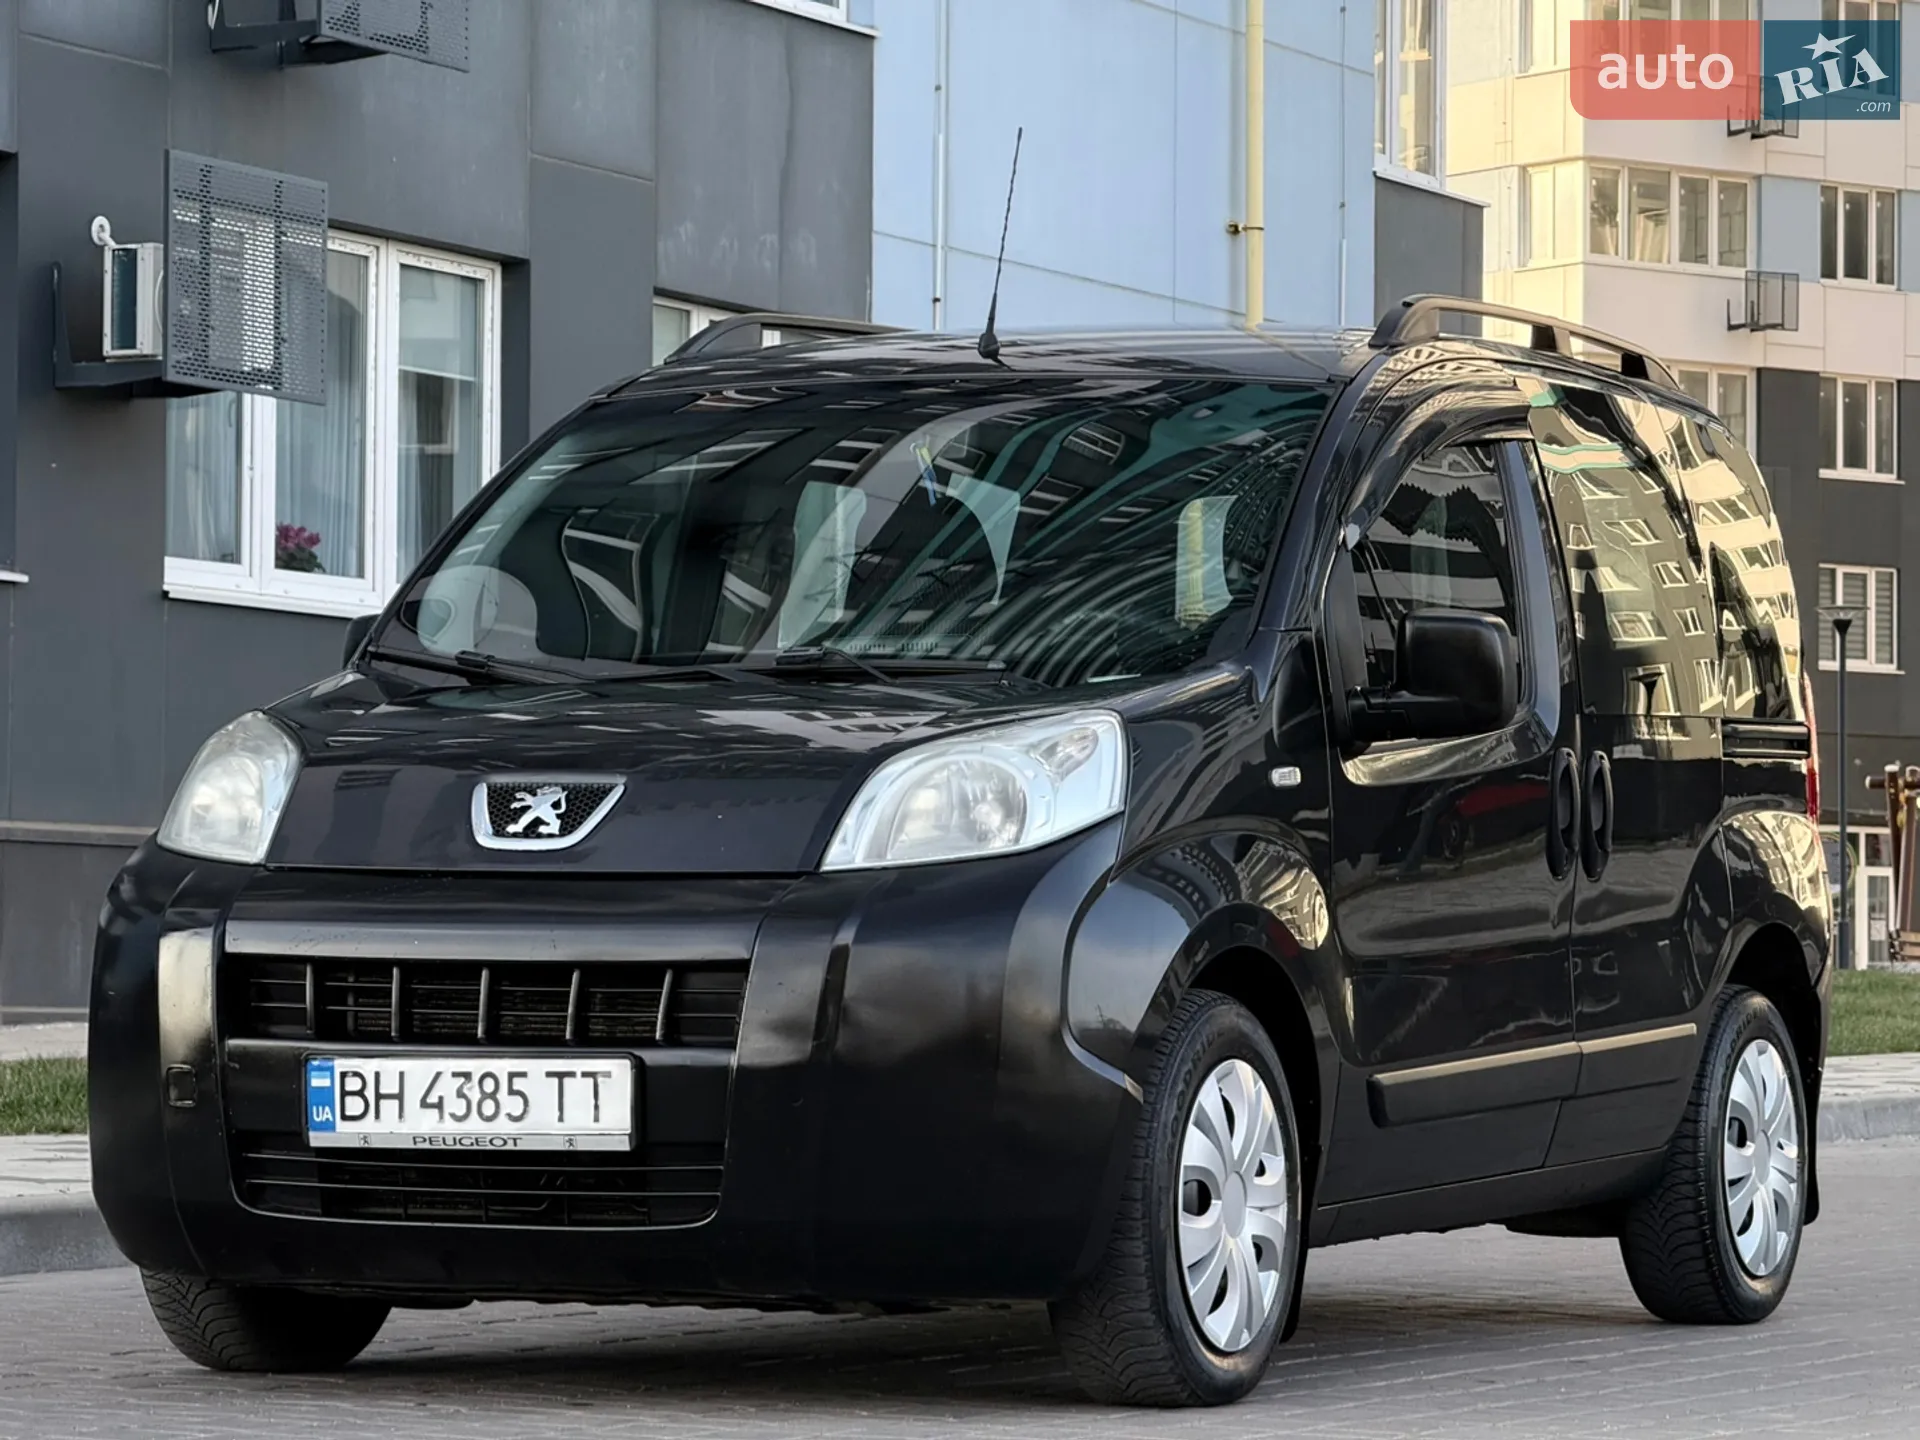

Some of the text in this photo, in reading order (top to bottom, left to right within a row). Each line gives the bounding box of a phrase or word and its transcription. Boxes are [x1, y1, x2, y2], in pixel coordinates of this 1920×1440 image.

[339, 1070, 612, 1123] BH 4385 TT
[312, 1105, 334, 1122] UA
[412, 1135, 523, 1148] PEUGEOT
